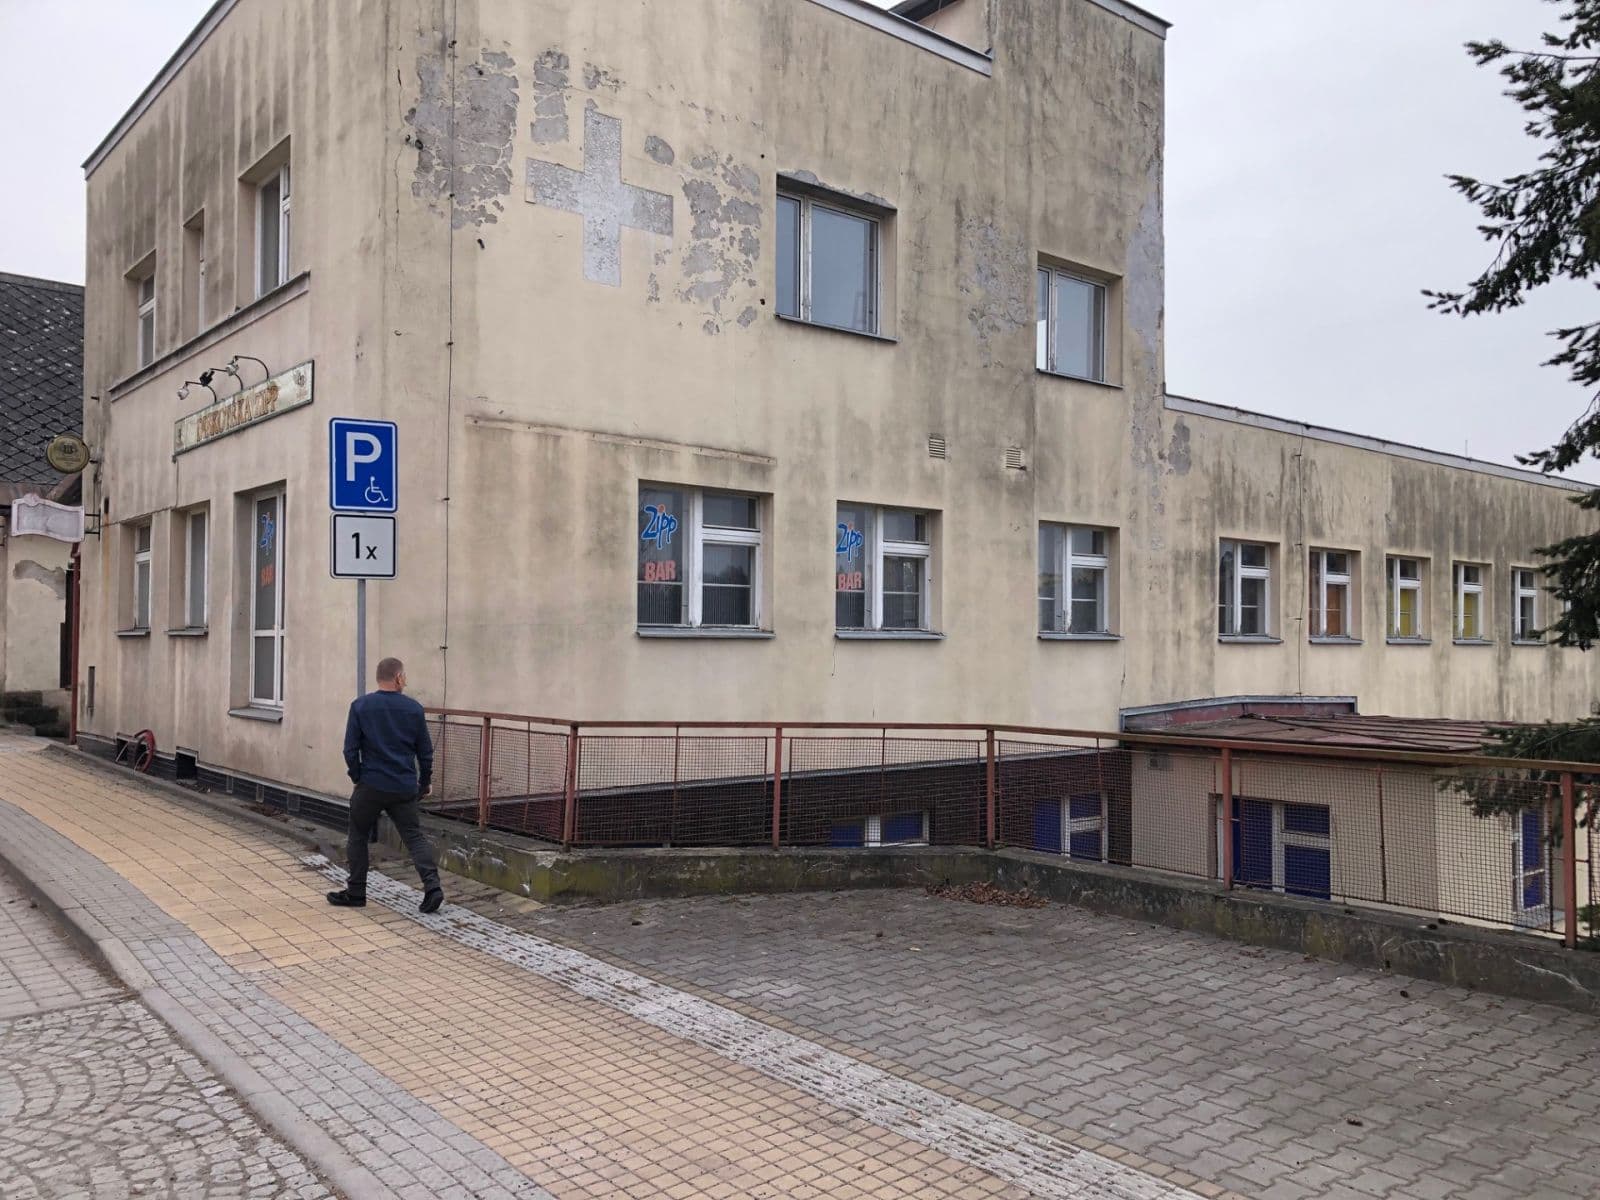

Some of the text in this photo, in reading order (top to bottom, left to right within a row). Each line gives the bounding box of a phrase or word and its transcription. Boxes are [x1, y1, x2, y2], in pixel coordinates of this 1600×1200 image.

[346, 431, 382, 482] P
[641, 504, 678, 550] Zipp
[836, 522, 863, 562] Zipp
[644, 560, 676, 583] BAR
[837, 571, 862, 591] BAR
